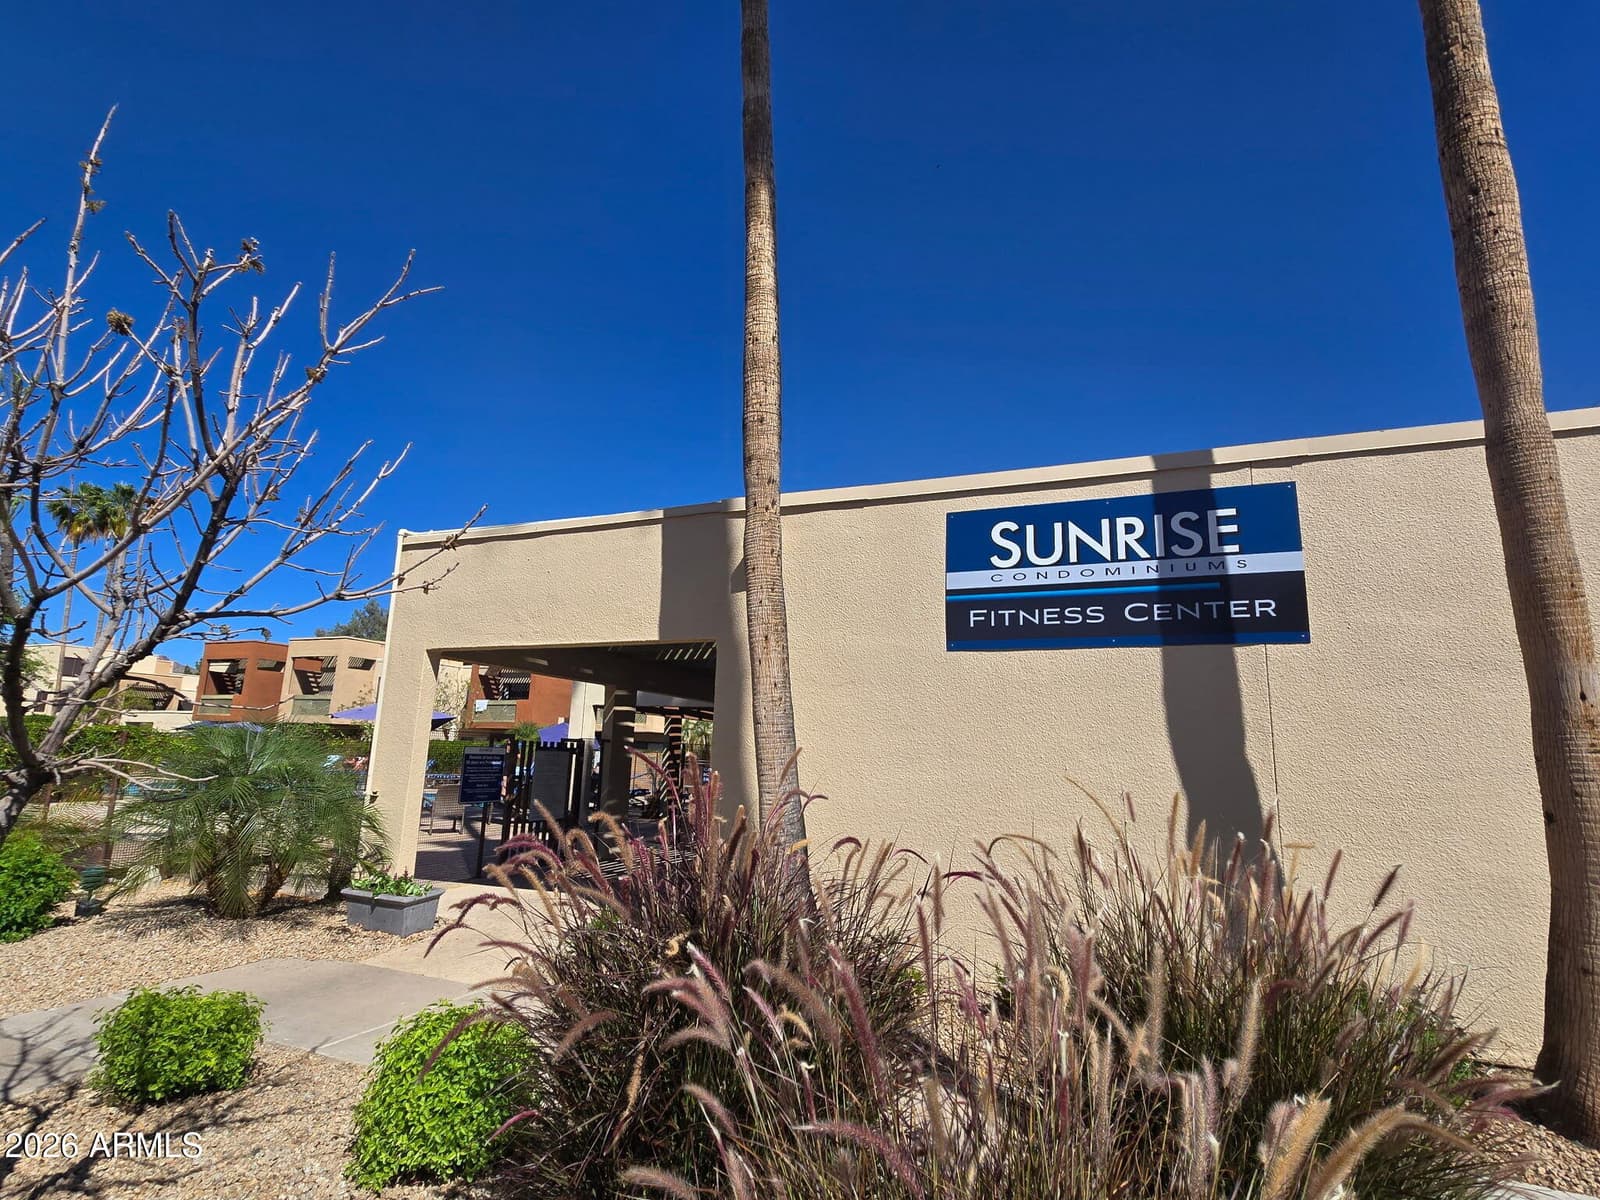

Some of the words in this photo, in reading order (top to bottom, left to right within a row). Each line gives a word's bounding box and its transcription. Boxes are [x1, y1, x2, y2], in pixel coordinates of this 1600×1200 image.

[990, 507, 1240, 569] SUNRISE
[990, 559, 1248, 583] CONDOMINIUMS
[969, 606, 1105, 628] FITNESS
[1124, 599, 1277, 622] CENTER
